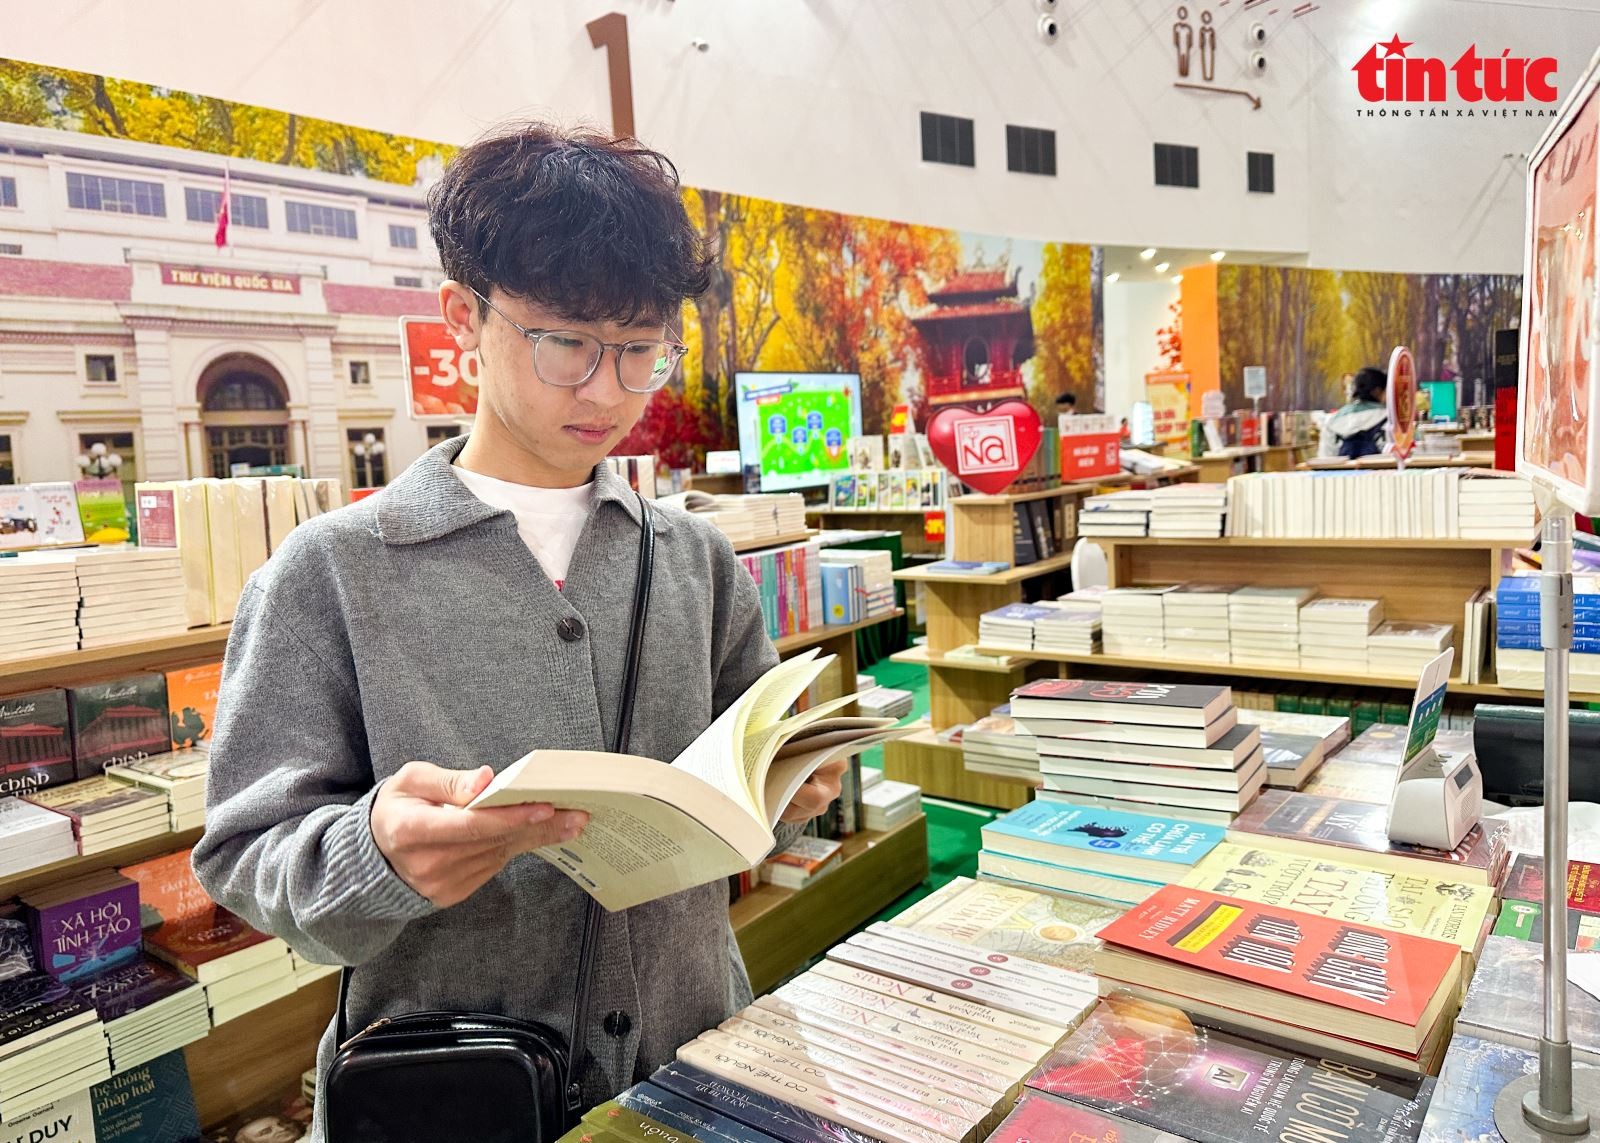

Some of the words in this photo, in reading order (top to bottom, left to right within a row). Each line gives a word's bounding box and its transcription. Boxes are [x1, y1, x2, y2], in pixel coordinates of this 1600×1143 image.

[586, 11, 636, 143] 1
[171, 270, 200, 284] THƯ
[201, 271, 232, 287] VIỆN
[233, 273, 269, 289] QUỐC
[271, 279, 294, 291] GIA
[1290, 877, 1350, 915] TÂY
[1398, 877, 1428, 896] TẠI
[61, 911, 85, 933] XÃ
[90, 901, 122, 923] HỘI
[1174, 898, 1200, 917] MATT
[1383, 905, 1413, 929] SAO
[1138, 915, 1175, 940] RIDLEY
[853, 971, 912, 996] Nexus
[735, 1040, 772, 1058] NGƯỜI
[716, 1053, 755, 1073] NGƯỜI
[774, 1054, 801, 1071] THỂ
[804, 1065, 826, 1079] CƠ
[1264, 1059, 1282, 1078] TRONG
[754, 1069, 783, 1085] THỂ
[1211, 1067, 1235, 1084] AI
[1308, 1058, 1381, 1103] BÀN
[96, 1091, 129, 1116] pháp
[131, 1078, 155, 1097] luật
[784, 1081, 808, 1094] CƠ
[1295, 1091, 1364, 1129] CỜ
[29, 1114, 73, 1143] DUY
